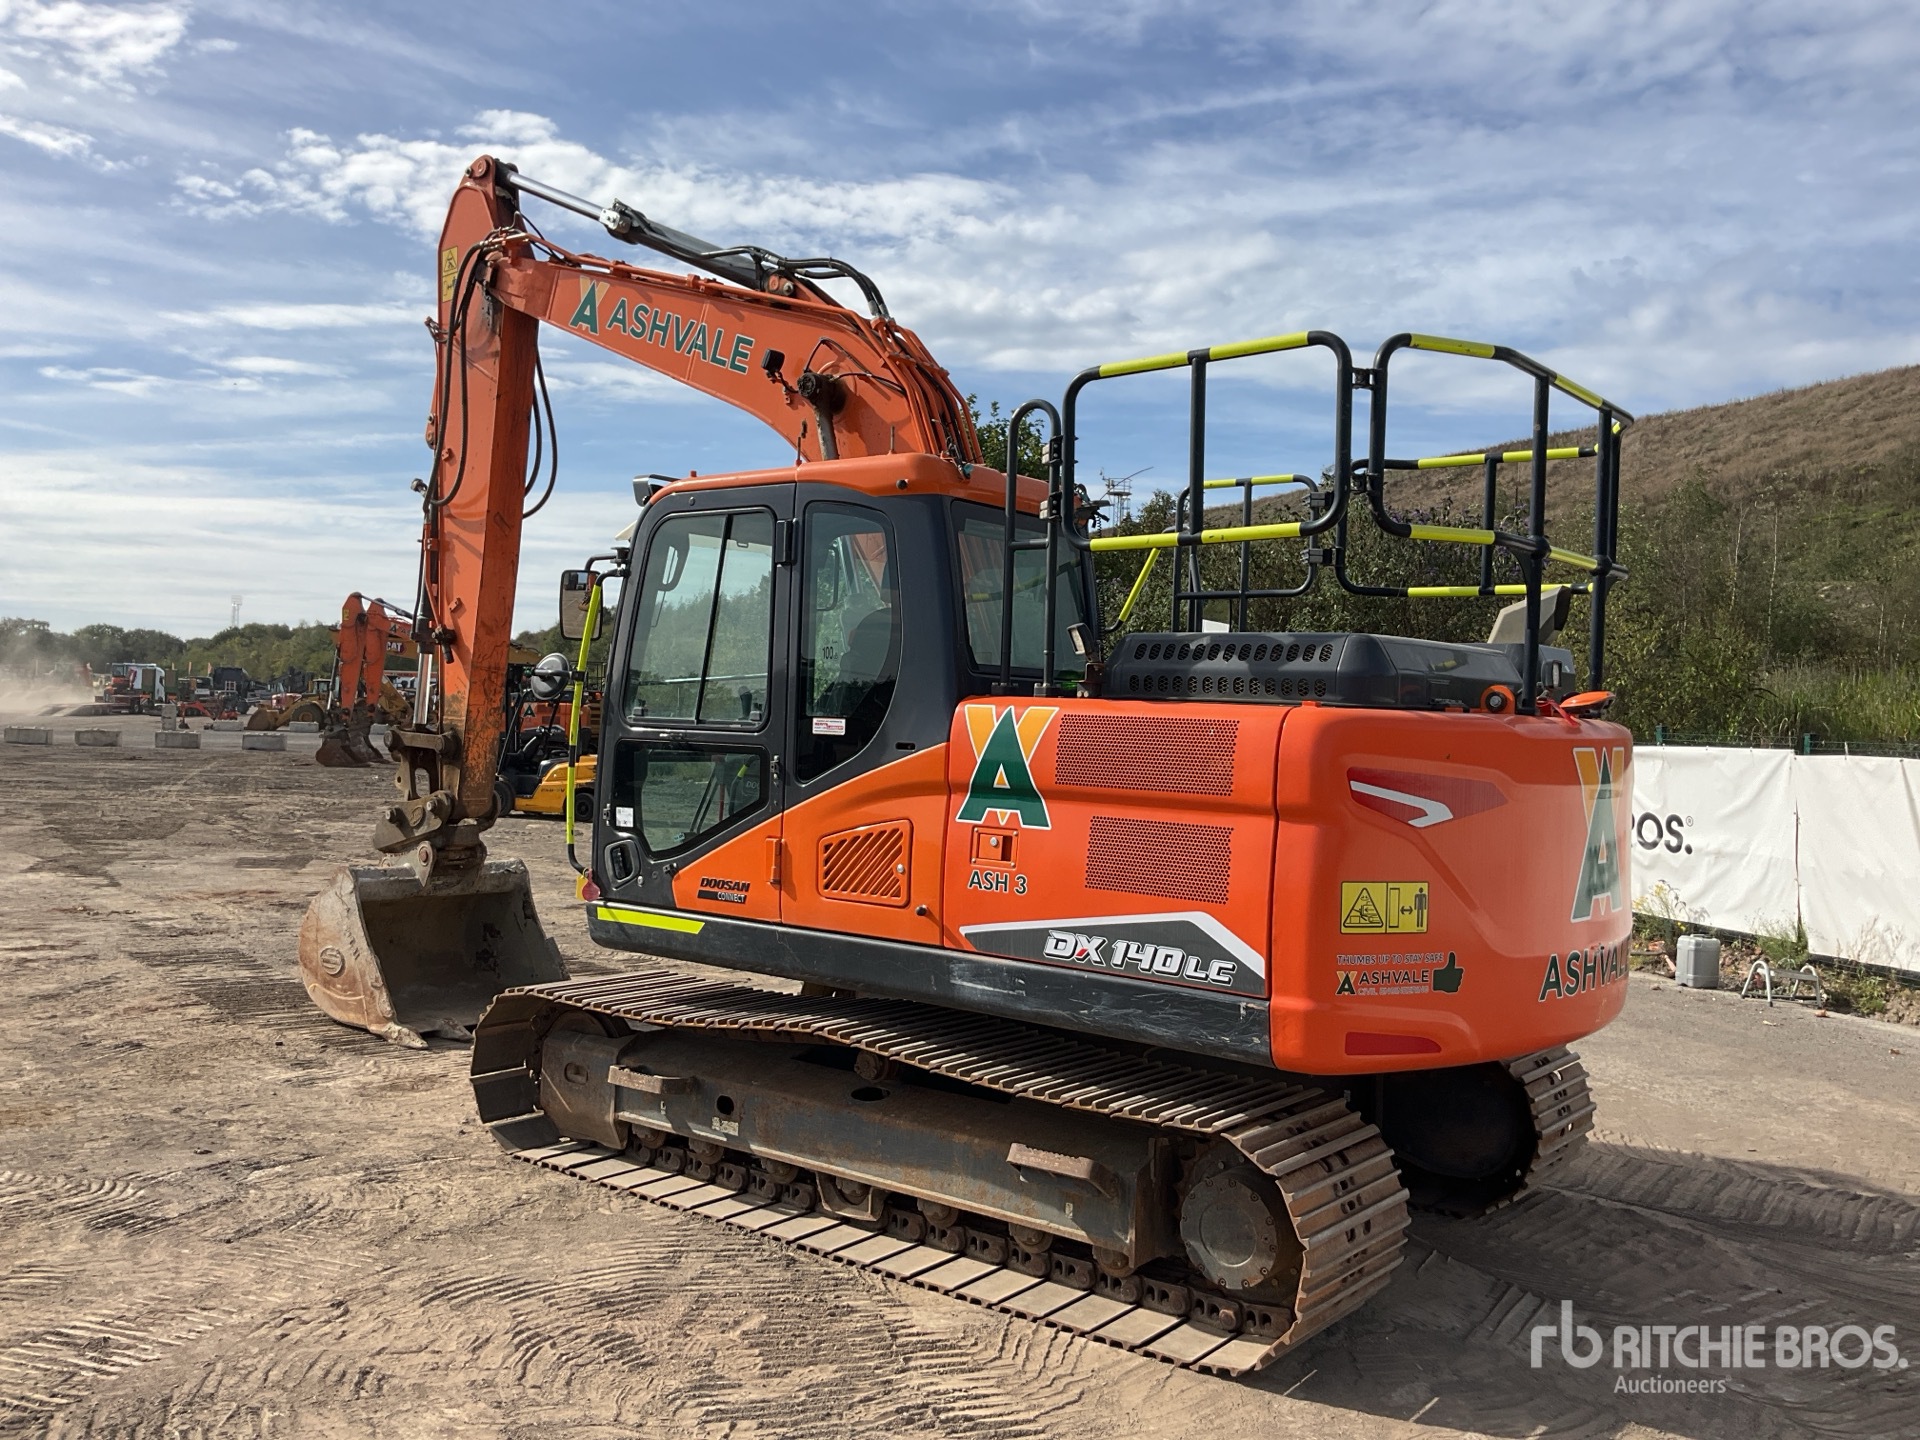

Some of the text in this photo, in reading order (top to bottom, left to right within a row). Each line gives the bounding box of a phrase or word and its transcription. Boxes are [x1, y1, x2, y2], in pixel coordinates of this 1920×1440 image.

[606, 297, 755, 375] ASHVALE
[386, 641, 402, 652] CAT
[700, 877, 750, 893] DOOSAN
[967, 870, 1028, 896] ASH 3
[717, 891, 745, 903] CONNECT
[1043, 929, 1108, 967] DX
[1336, 952, 1444, 965] THUMBS UP TO STAY SAFE
[1358, 969, 1430, 985] ASHVALE
